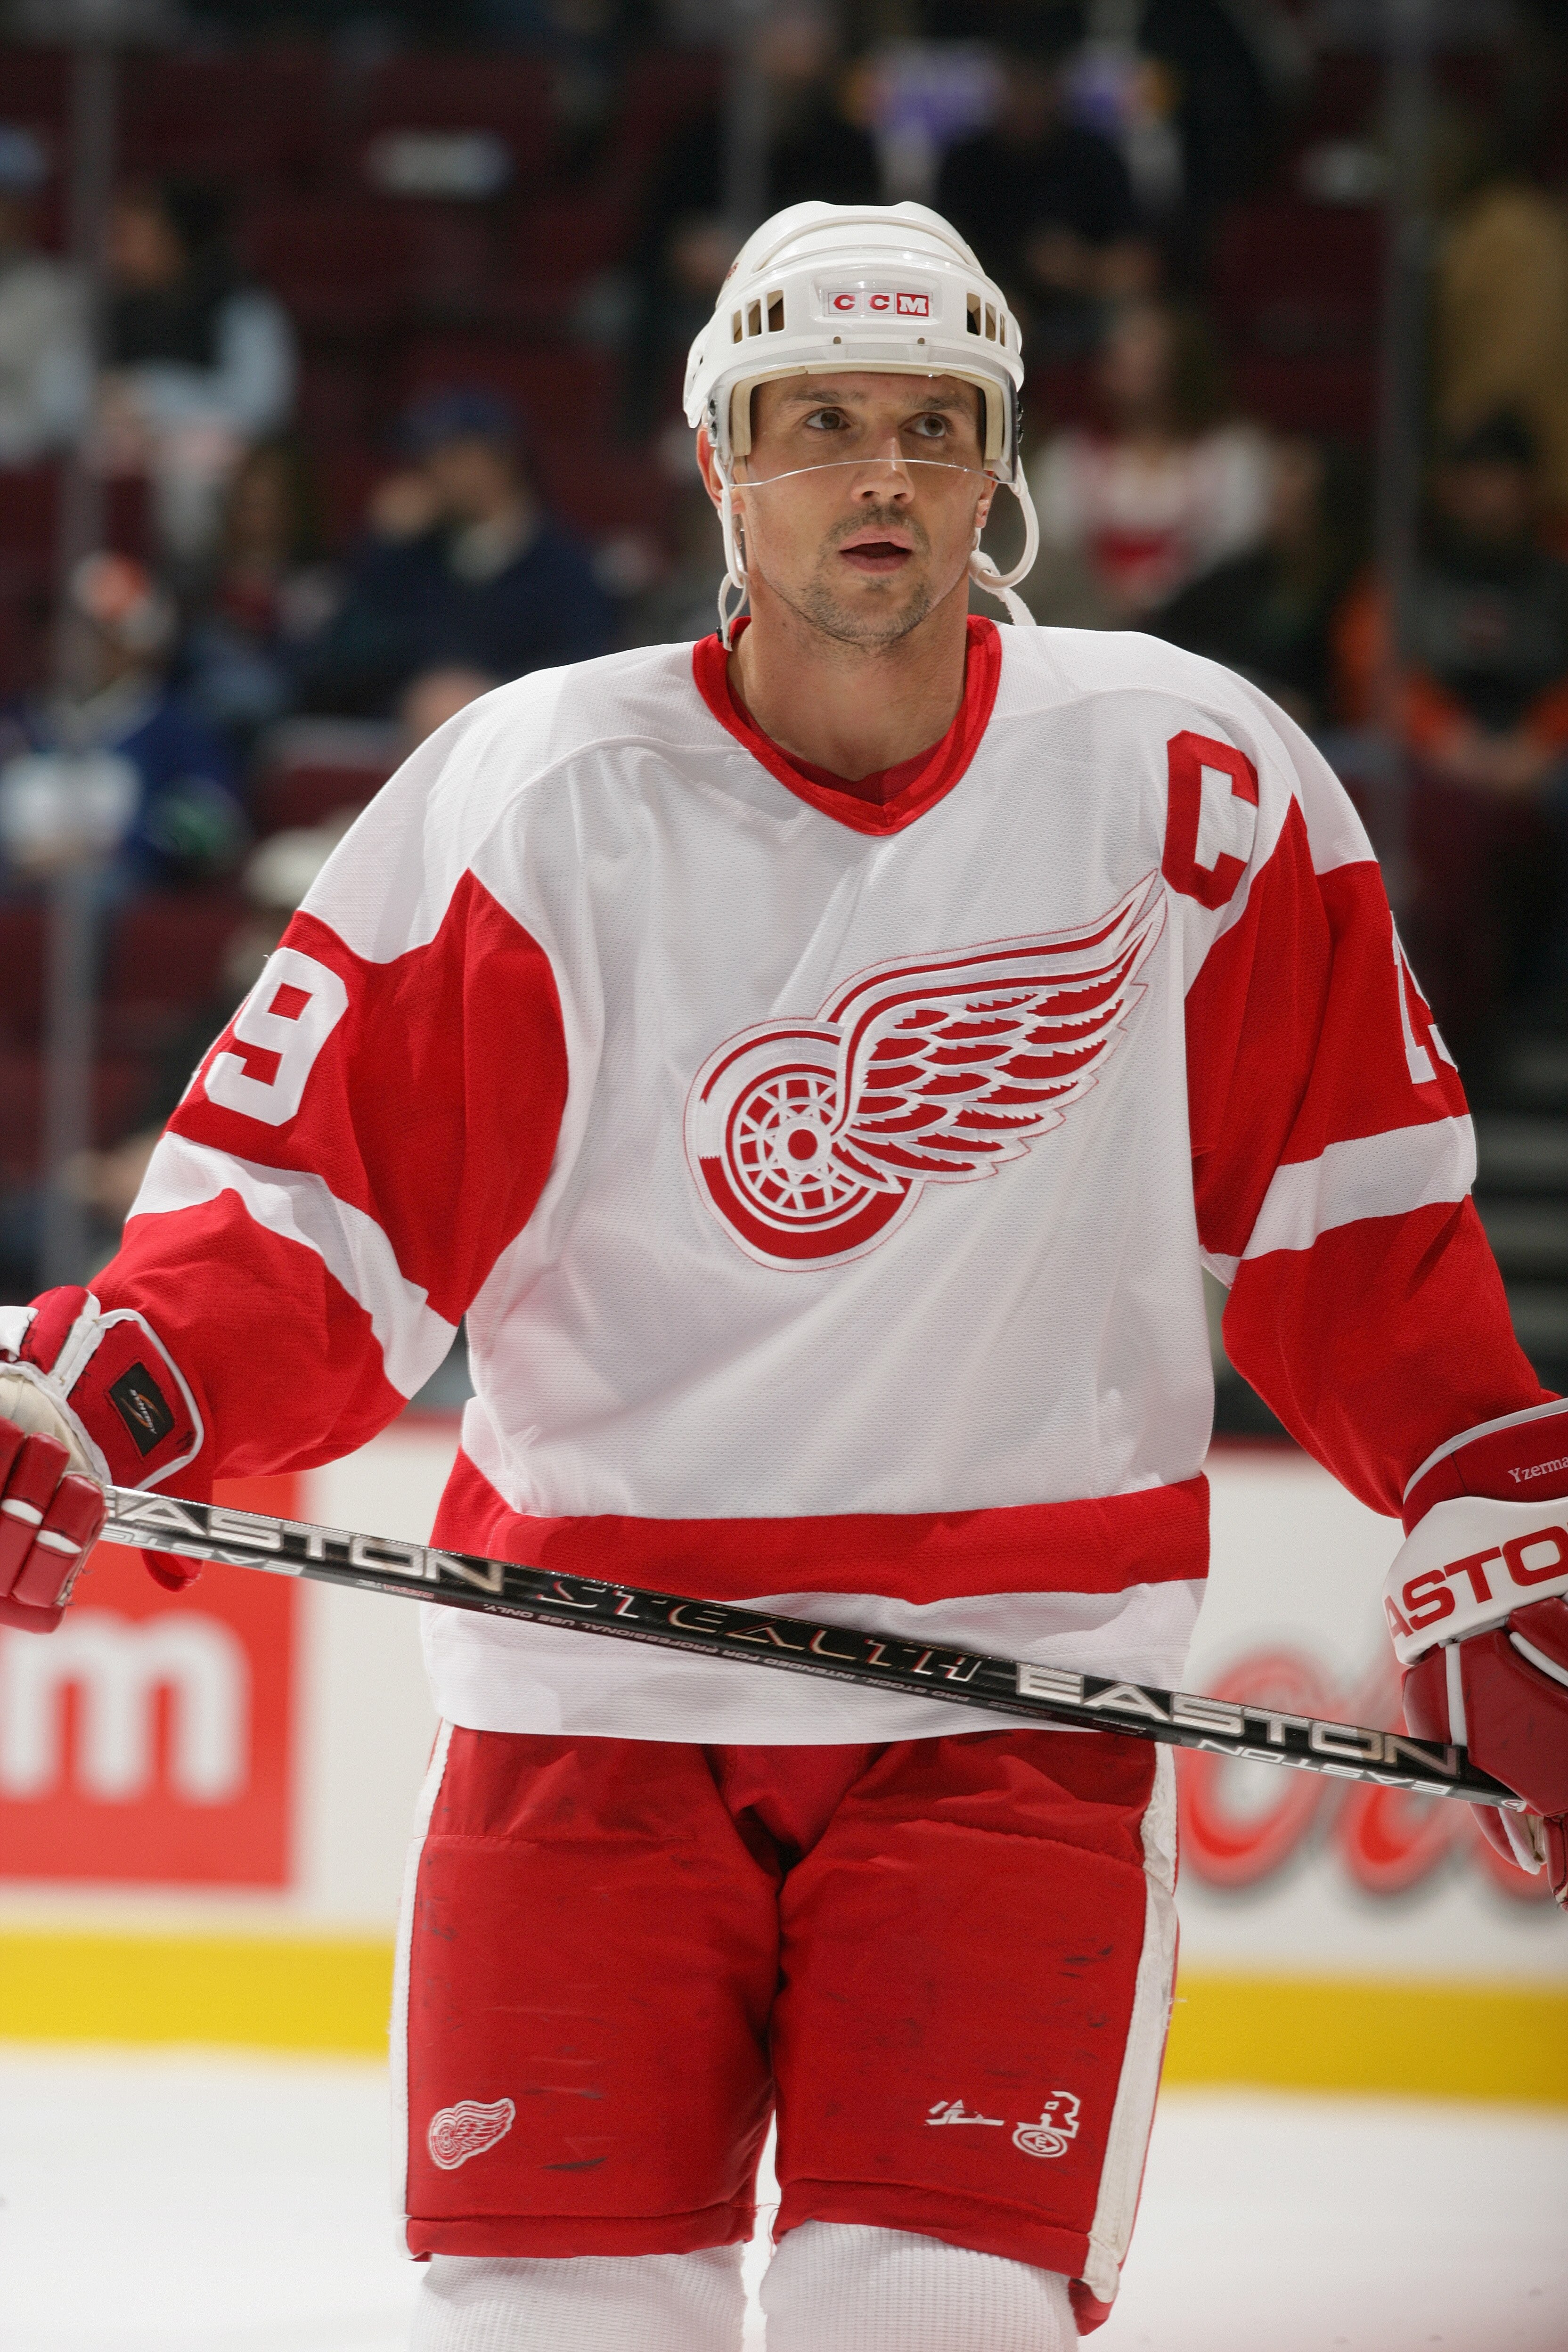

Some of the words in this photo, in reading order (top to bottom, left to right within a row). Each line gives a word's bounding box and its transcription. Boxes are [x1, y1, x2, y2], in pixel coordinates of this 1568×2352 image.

[833, 293, 929, 317] CCM
[1161, 730, 1259, 911] C
[1390, 910, 1458, 1084] 1
[177, 947, 349, 1127] 9
[1508, 1456, 1568, 1483] Yzerma
[98, 1528, 305, 1576] EASTO
[105, 1487, 505, 1594] ASTON
[1384, 1523, 1568, 1639] ASTO
[483, 1603, 534, 1619] ONLY.
[538, 1614, 576, 1626] USE
[536, 1581, 982, 1682] STEALTH
[581, 1622, 719, 1654] PROFESSIONAL
[722, 1649, 760, 1662] FOR
[763, 1657, 856, 1681] INTENDED
[862, 1675, 927, 1694] STOCK.
[931, 1690, 970, 1701] PRO
[1016, 1663, 1462, 1780] EASTON
[1197, 1739, 1453, 1796] EASTON
